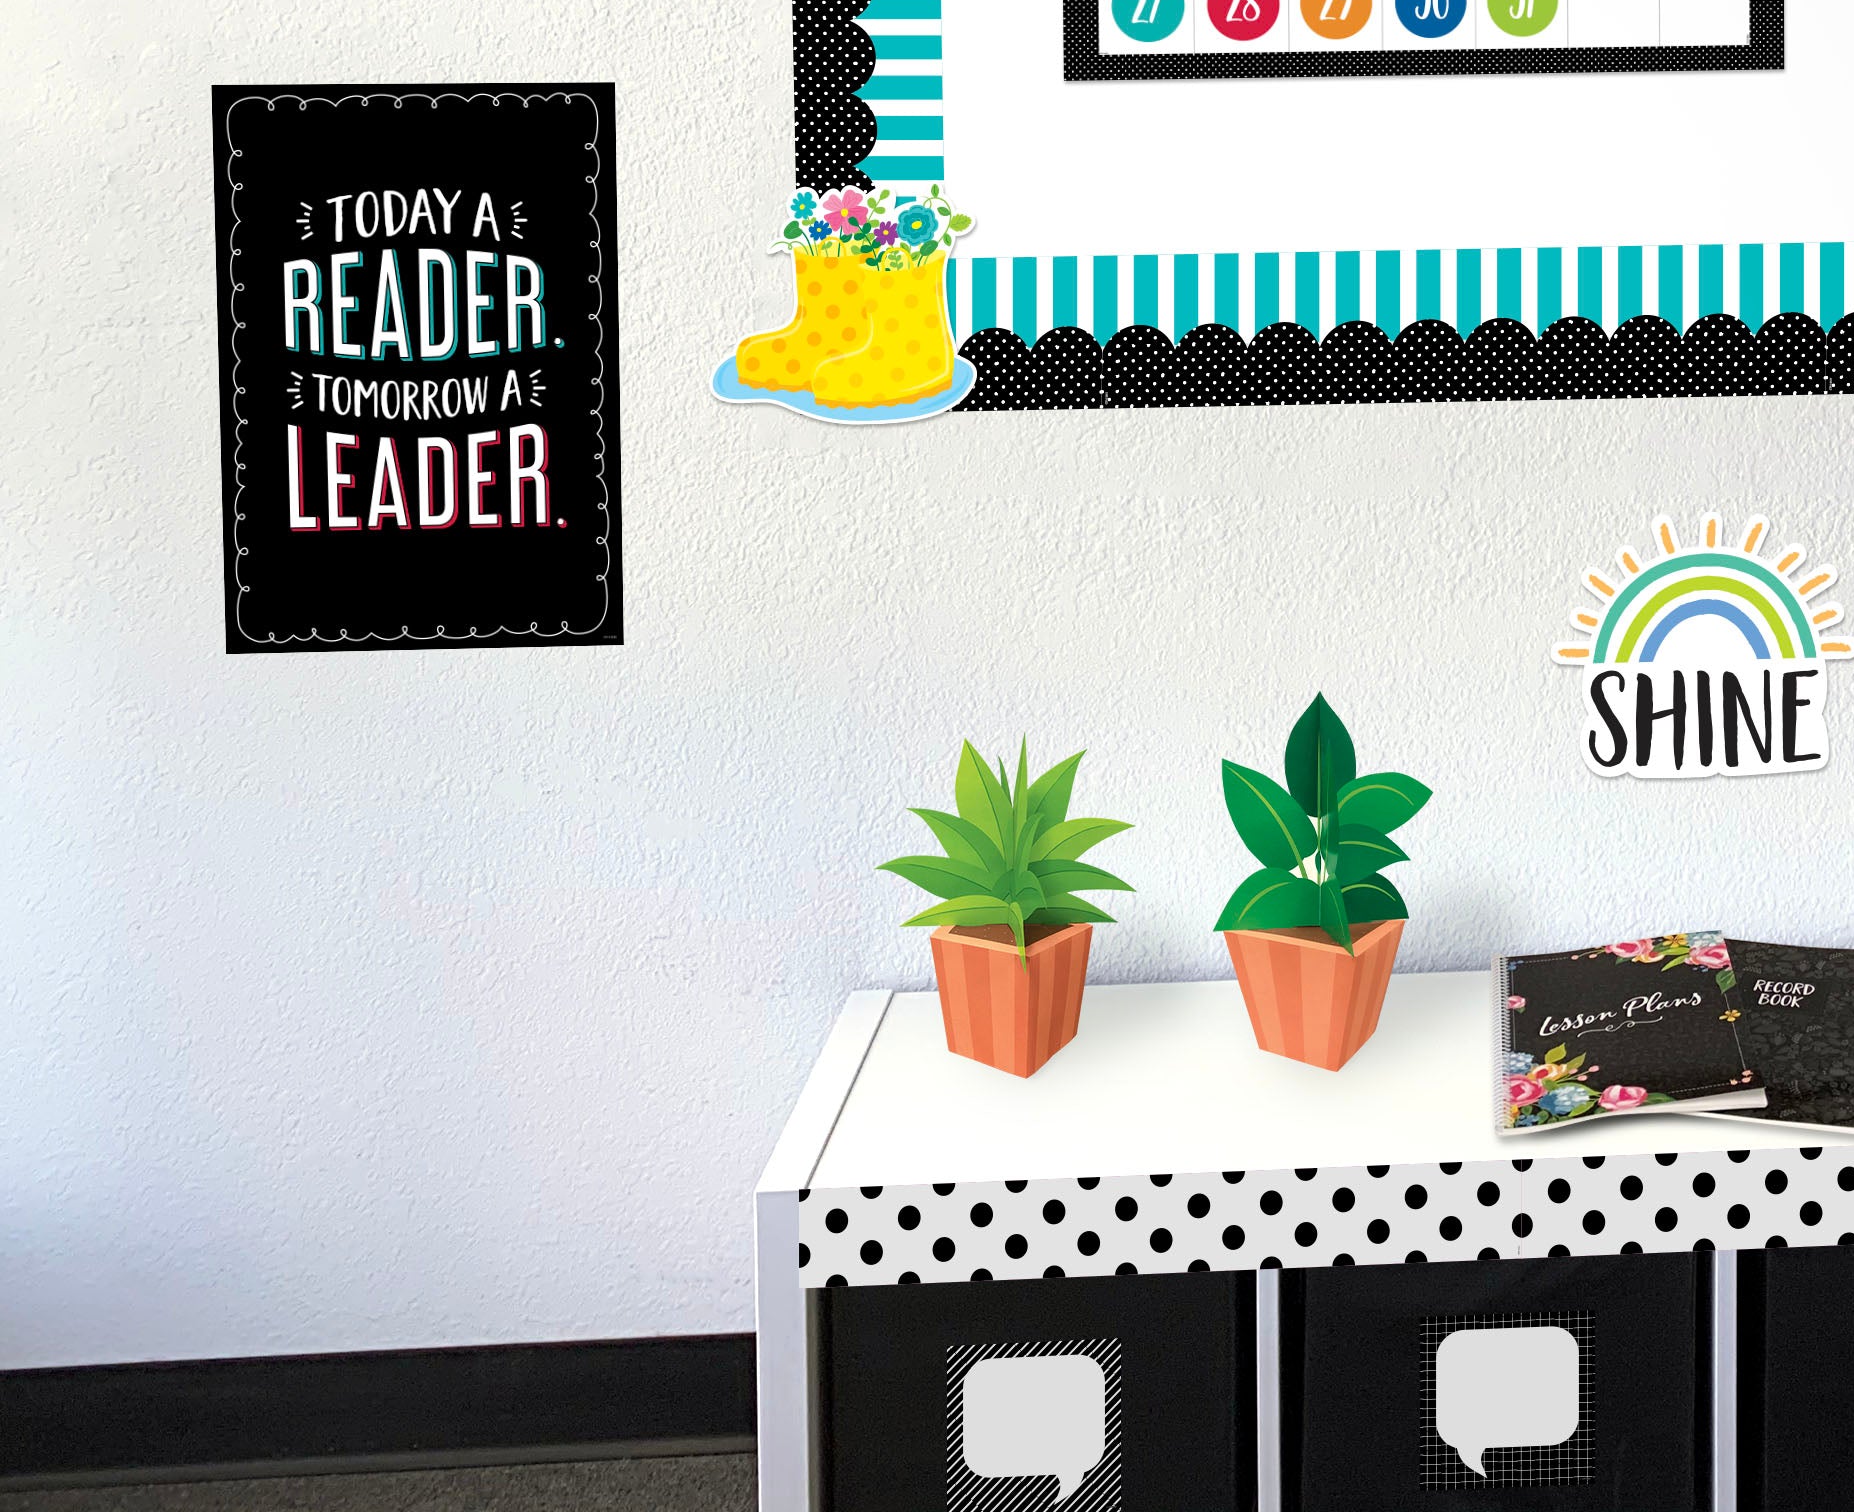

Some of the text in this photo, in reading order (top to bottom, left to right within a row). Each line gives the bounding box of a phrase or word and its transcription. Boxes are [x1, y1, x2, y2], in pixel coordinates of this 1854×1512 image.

[327, 188, 500, 242] TODAY A
[284, 249, 564, 361] READER.
[312, 370, 521, 420] TOMORROW A
[288, 423, 567, 531] LEADER.
[1589, 670, 1821, 770] SHINE
[1538, 990, 1702, 1037] Lesson Plans
[1753, 979, 1815, 997] RECORD
[1758, 993, 1803, 1009] BOOK
